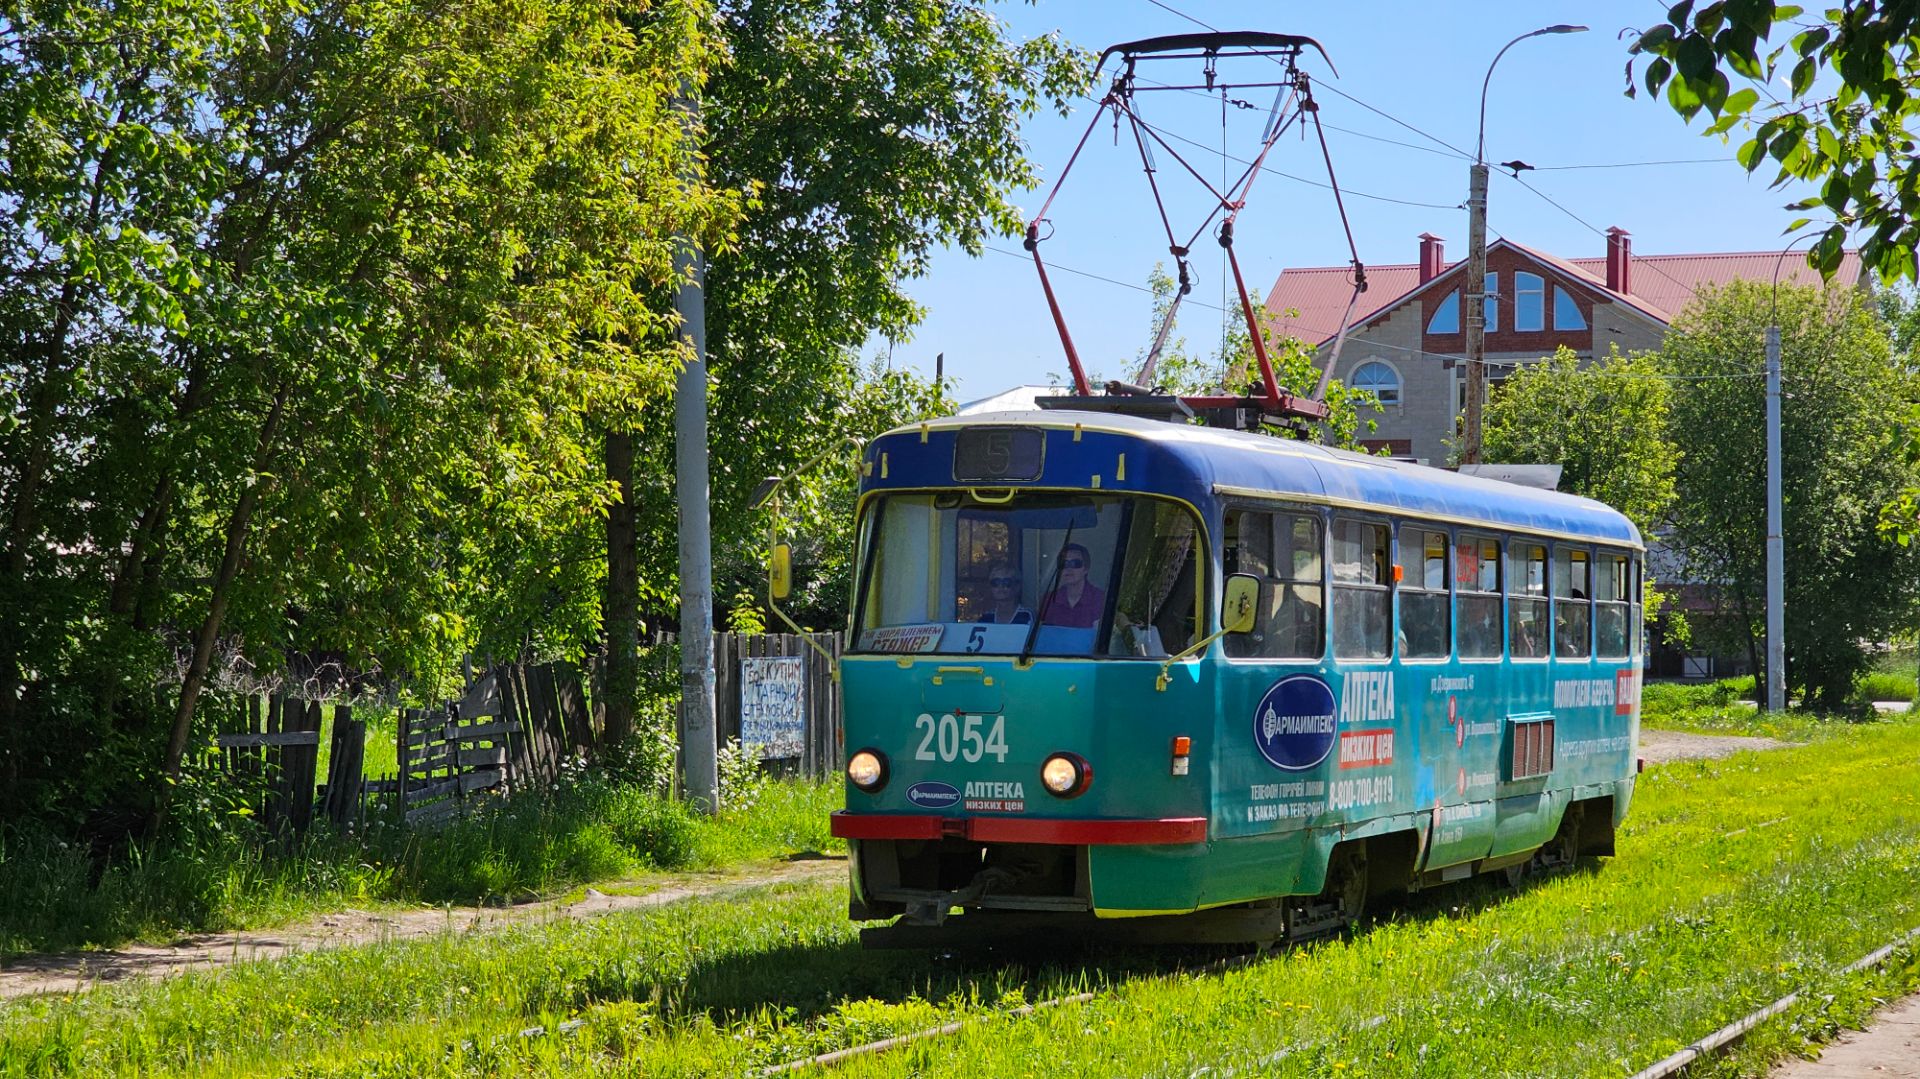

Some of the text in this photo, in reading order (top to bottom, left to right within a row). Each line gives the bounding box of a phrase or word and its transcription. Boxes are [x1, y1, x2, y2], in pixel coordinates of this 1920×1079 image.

[871, 636, 929, 651] СТАЖЕР
[966, 626, 987, 652] 5
[1340, 671, 1395, 723] АПТЕКА
[1554, 680, 1591, 708] ПОМОГАЕМ
[1591, 679, 1615, 706] БЕРЕЧЬ
[915, 713, 1009, 763] 2054
[964, 781, 1025, 799] АПТЕКА
[1250, 784, 1279, 801] ТЕЛЕФОН
[1278, 780, 1305, 798] ГОРЯЧЕЙ
[1328, 775, 1393, 811] 8-800-700-9119
[1254, 803, 1278, 821] ЗАКАЗ
[1289, 801, 1325, 818] ТЕЛЕФОНУ
